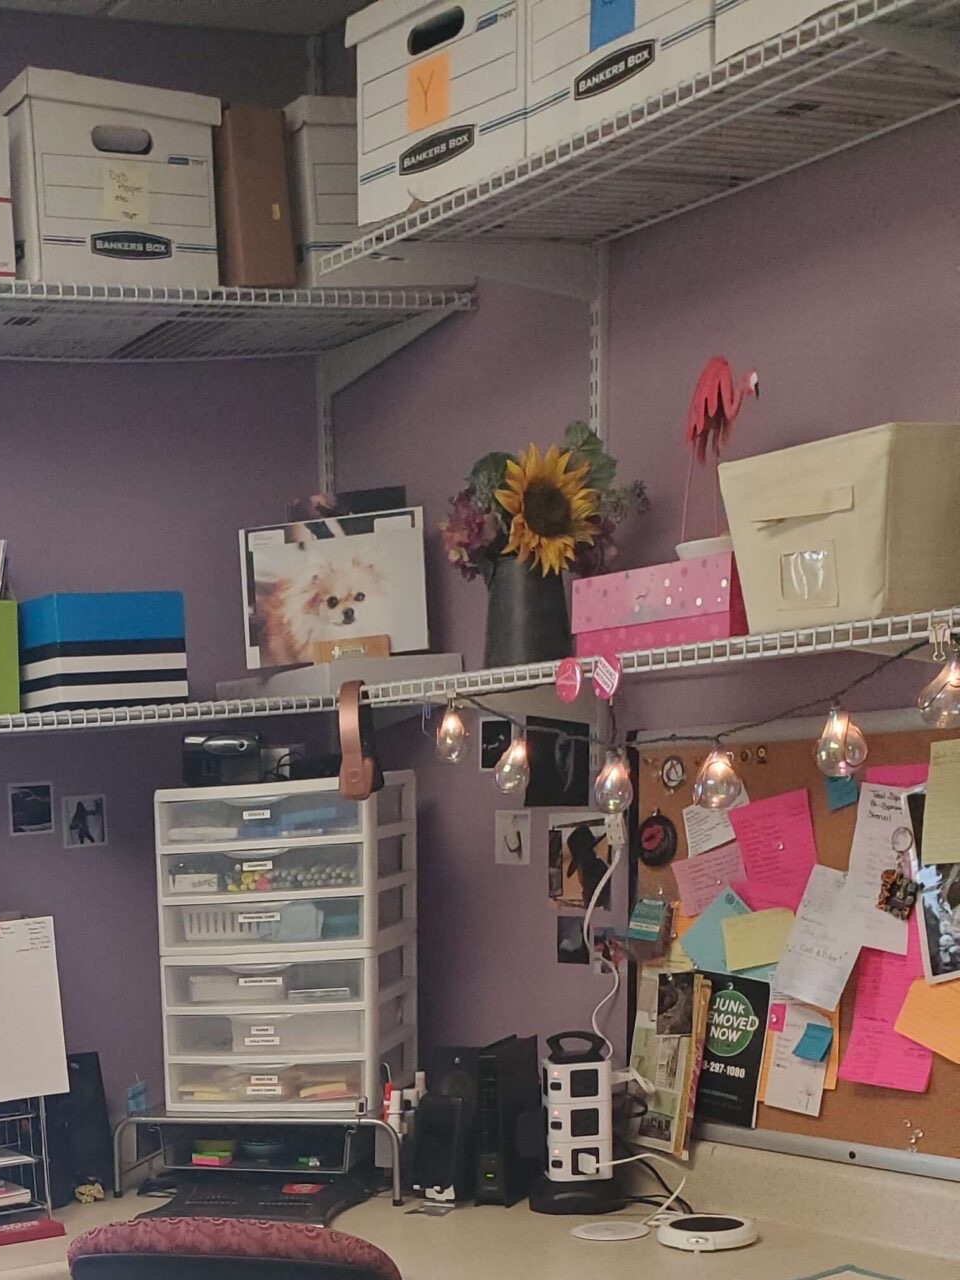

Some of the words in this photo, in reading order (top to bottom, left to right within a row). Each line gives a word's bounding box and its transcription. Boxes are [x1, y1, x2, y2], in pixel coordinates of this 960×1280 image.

[578, 61, 625, 92] BANKERS
[627, 48, 650, 68] BOX
[417, 69, 434, 113] Y
[403, 143, 446, 168] BANKERS
[448, 133, 470, 150] BOX
[95, 239, 144, 252] BANKERS
[145, 242, 167, 253] BOX
[713, 998, 746, 1015] JUNK
[707, 1011, 759, 1031] EMOVED
[709, 1025, 742, 1043] NOW
